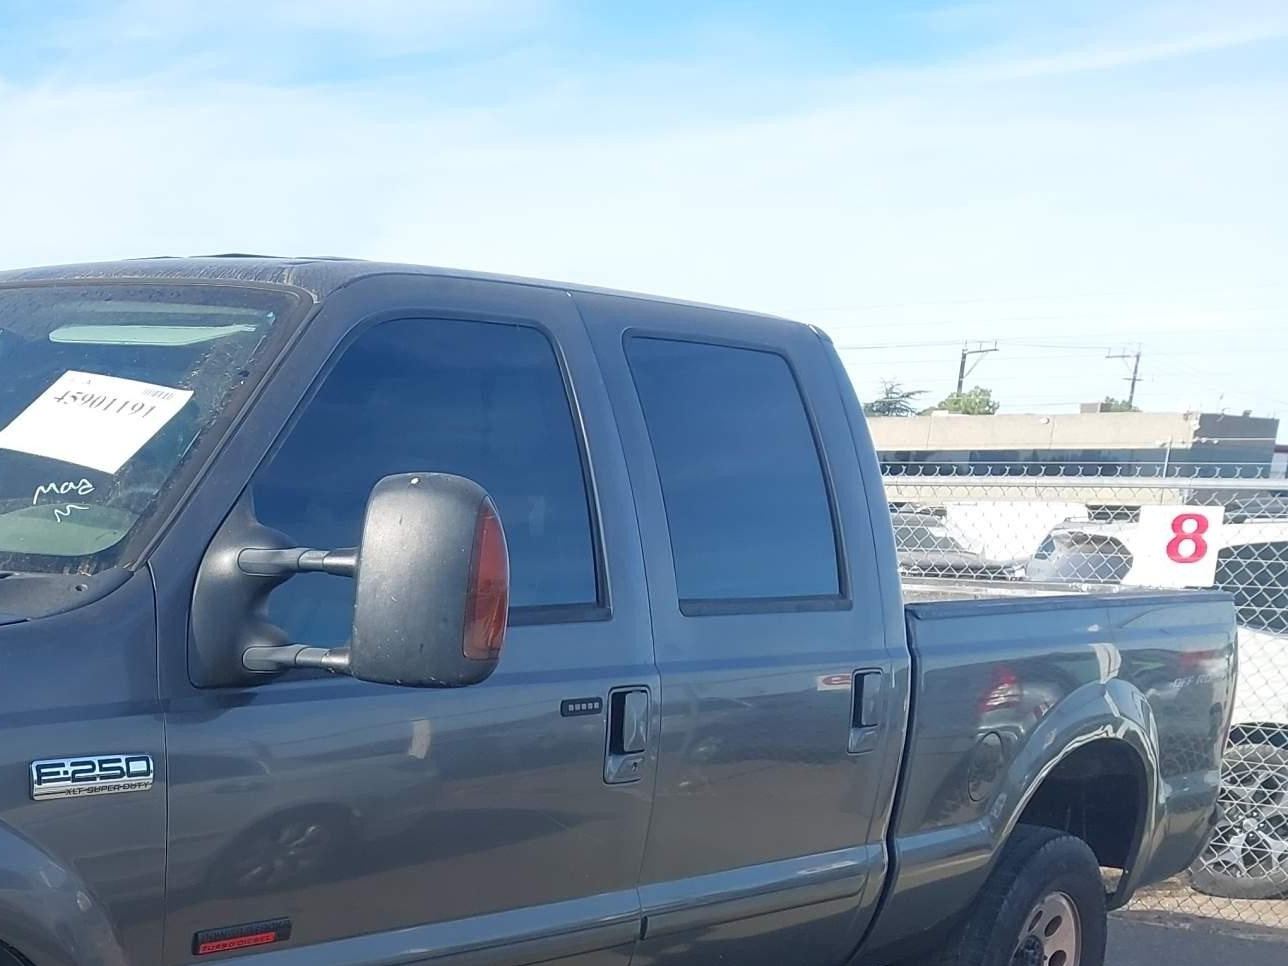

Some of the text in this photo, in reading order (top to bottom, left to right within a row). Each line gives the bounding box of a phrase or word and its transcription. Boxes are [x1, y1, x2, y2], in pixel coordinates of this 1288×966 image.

[53, 390, 157, 418] 45901191
[1166, 513, 1209, 564] 8
[35, 755, 152, 786] F-250
